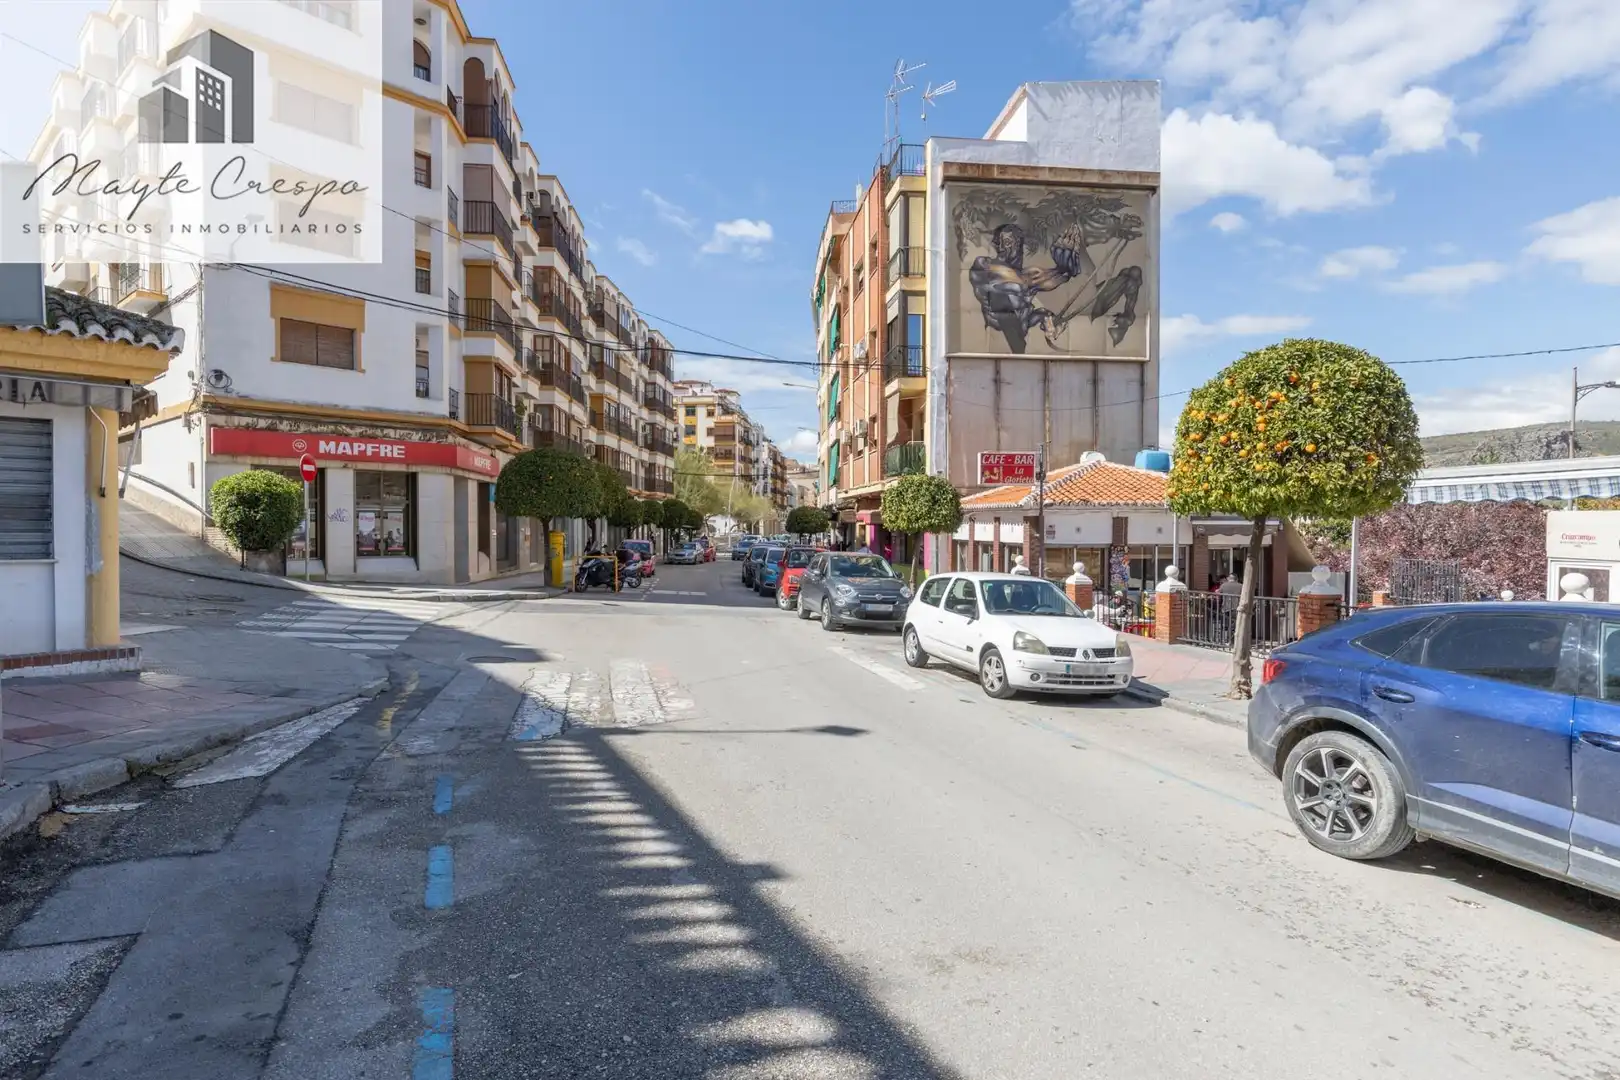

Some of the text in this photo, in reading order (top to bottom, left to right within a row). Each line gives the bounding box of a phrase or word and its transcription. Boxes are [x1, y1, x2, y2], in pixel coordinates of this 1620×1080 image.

[0, 378, 48, 402] IA
[318, 440, 405, 458] MAPFRE
[1014, 454, 1034, 465] BAR
[1015, 467, 1025, 475] La
